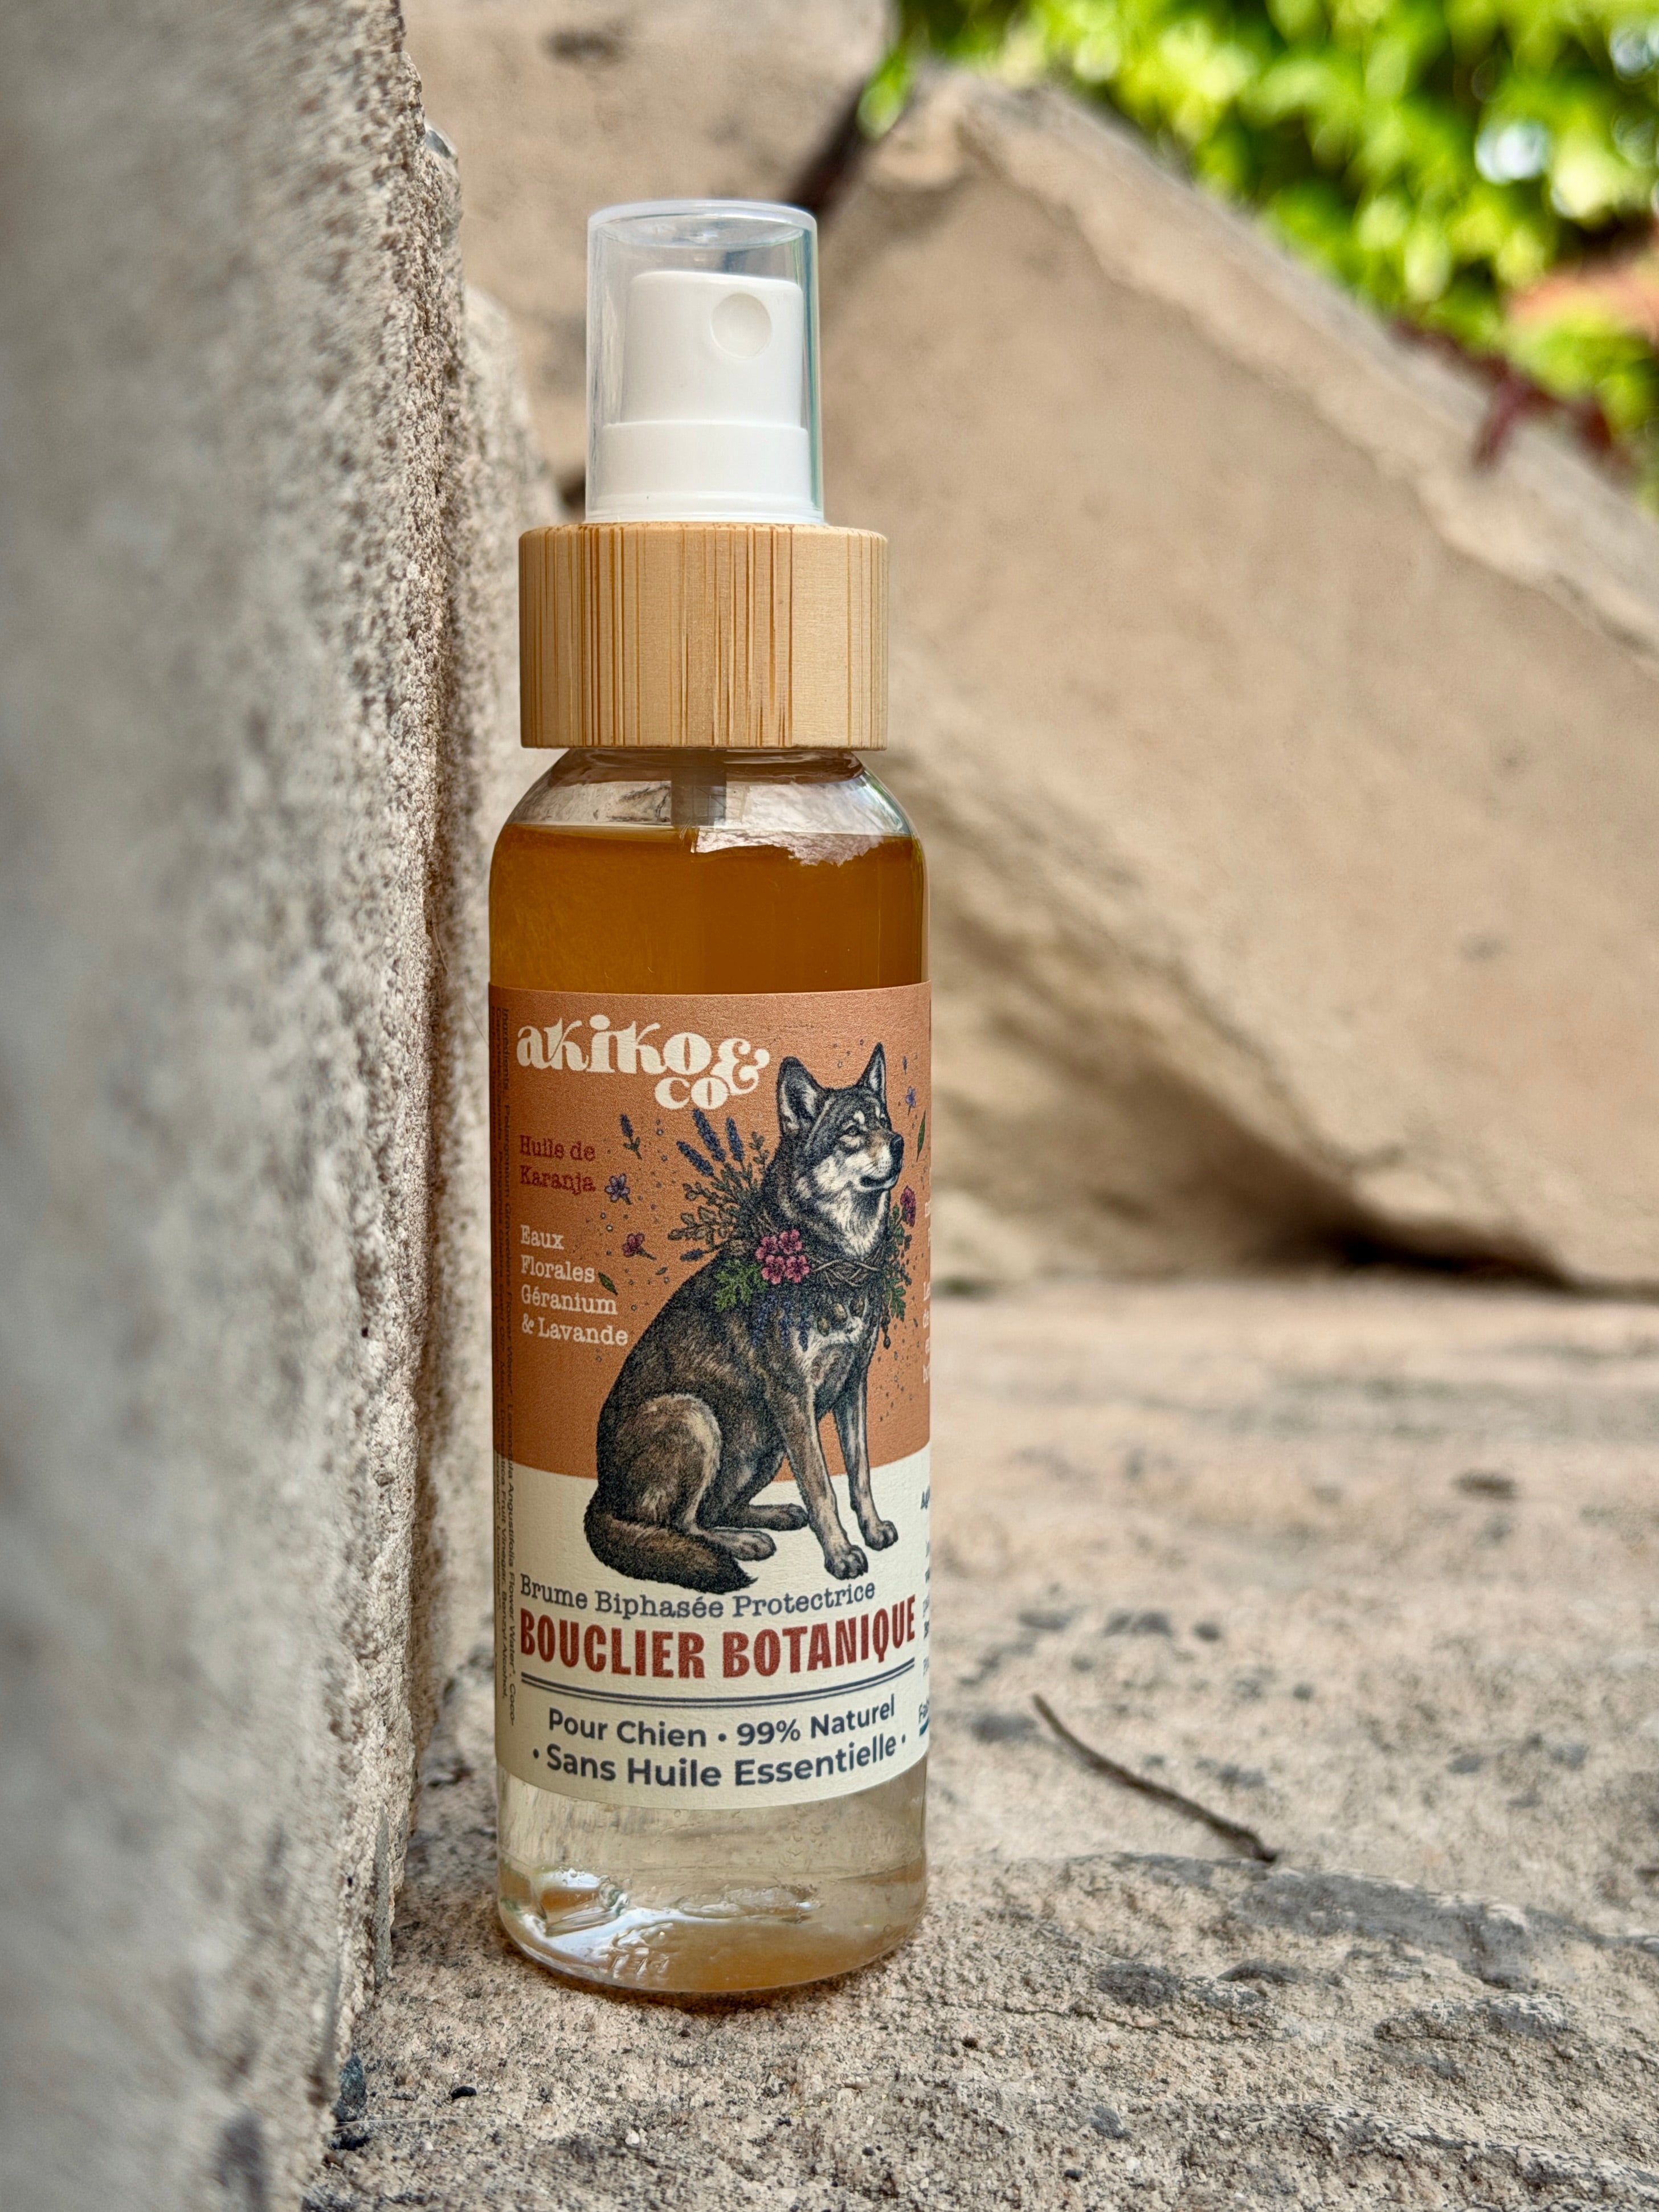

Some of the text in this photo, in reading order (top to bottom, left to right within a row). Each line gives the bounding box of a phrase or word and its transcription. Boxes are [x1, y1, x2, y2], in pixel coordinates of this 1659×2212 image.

[519, 1135, 596, 1163] Huile de
[519, 1165, 596, 1195] Karanja
[520, 1224, 565, 1251] Eaux
[520, 1255, 595, 1283] Florales
[521, 1285, 619, 1316] Géranium
[520, 1573, 876, 1621] Brume Biphasée Protectrice
[520, 1594, 916, 1679] BOUCLIER BOTANIQUE
[548, 1707, 609, 1741] Pour
[616, 1720, 706, 1747] Chien
[737, 1719, 800, 1746] 99%
[810, 1694, 896, 1739] Naturel
[546, 1733, 896, 1788] Sans Huile Essentielle
